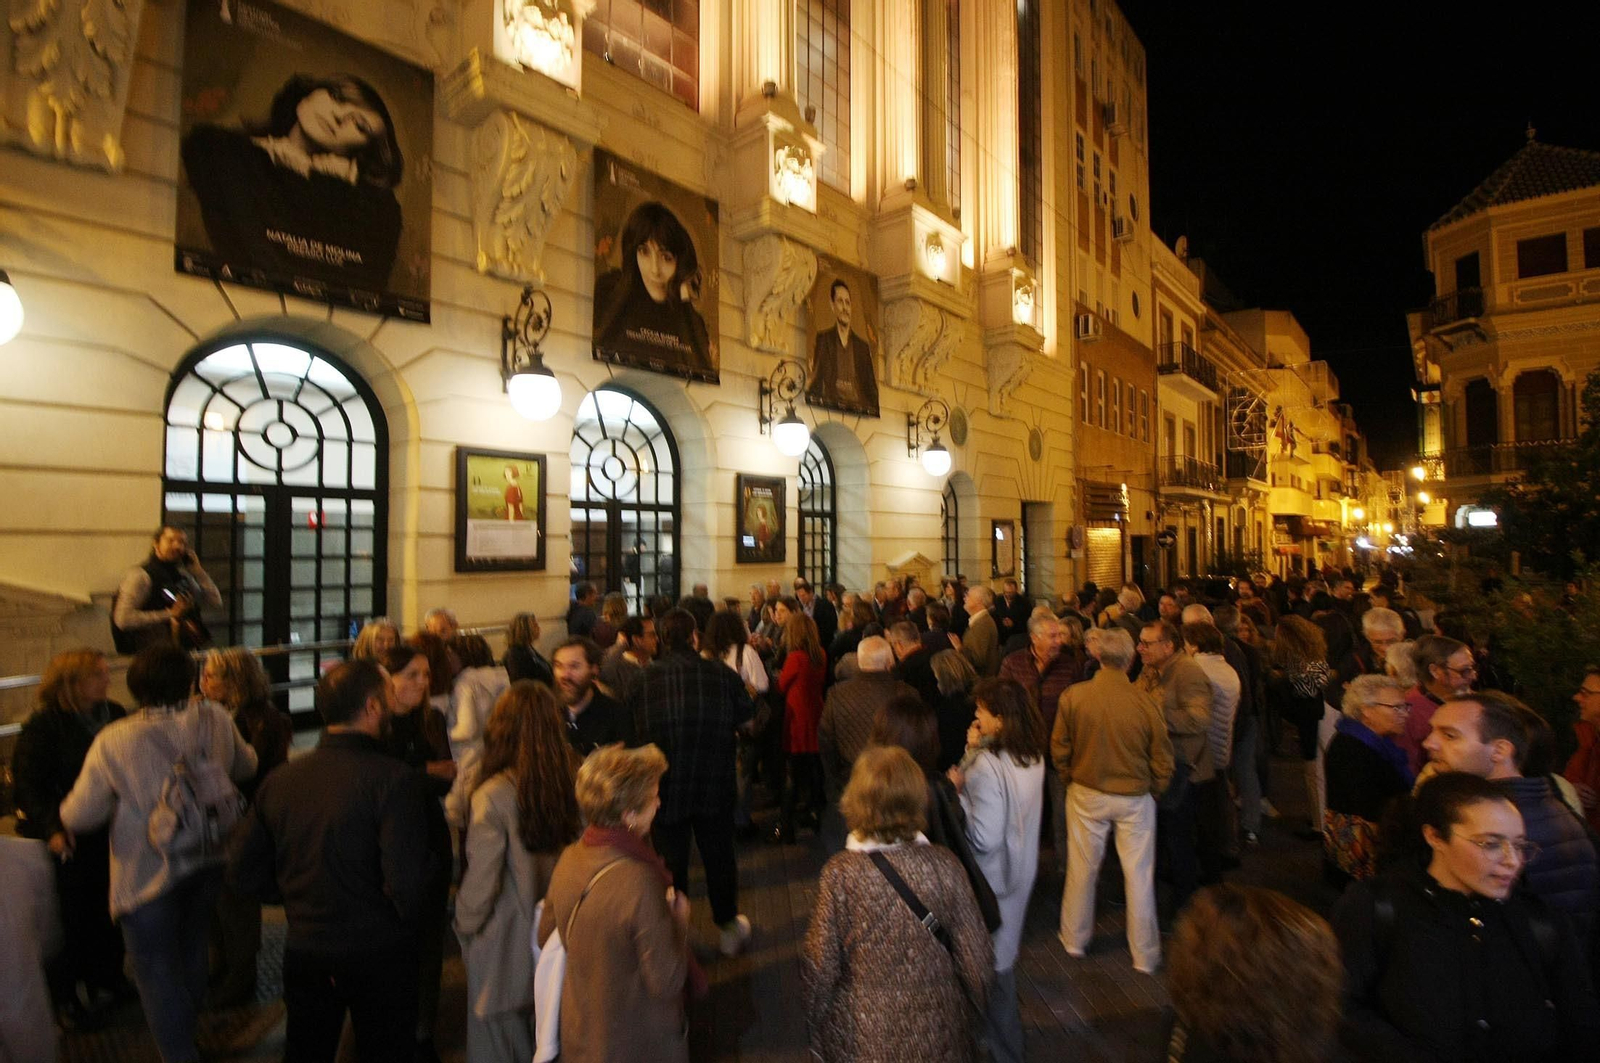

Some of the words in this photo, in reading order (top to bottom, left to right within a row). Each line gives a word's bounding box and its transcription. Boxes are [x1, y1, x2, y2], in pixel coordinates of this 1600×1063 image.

[266, 228, 308, 250] NATALIA
[310, 238, 323, 251] DE
[325, 243, 363, 264] MOLINA
